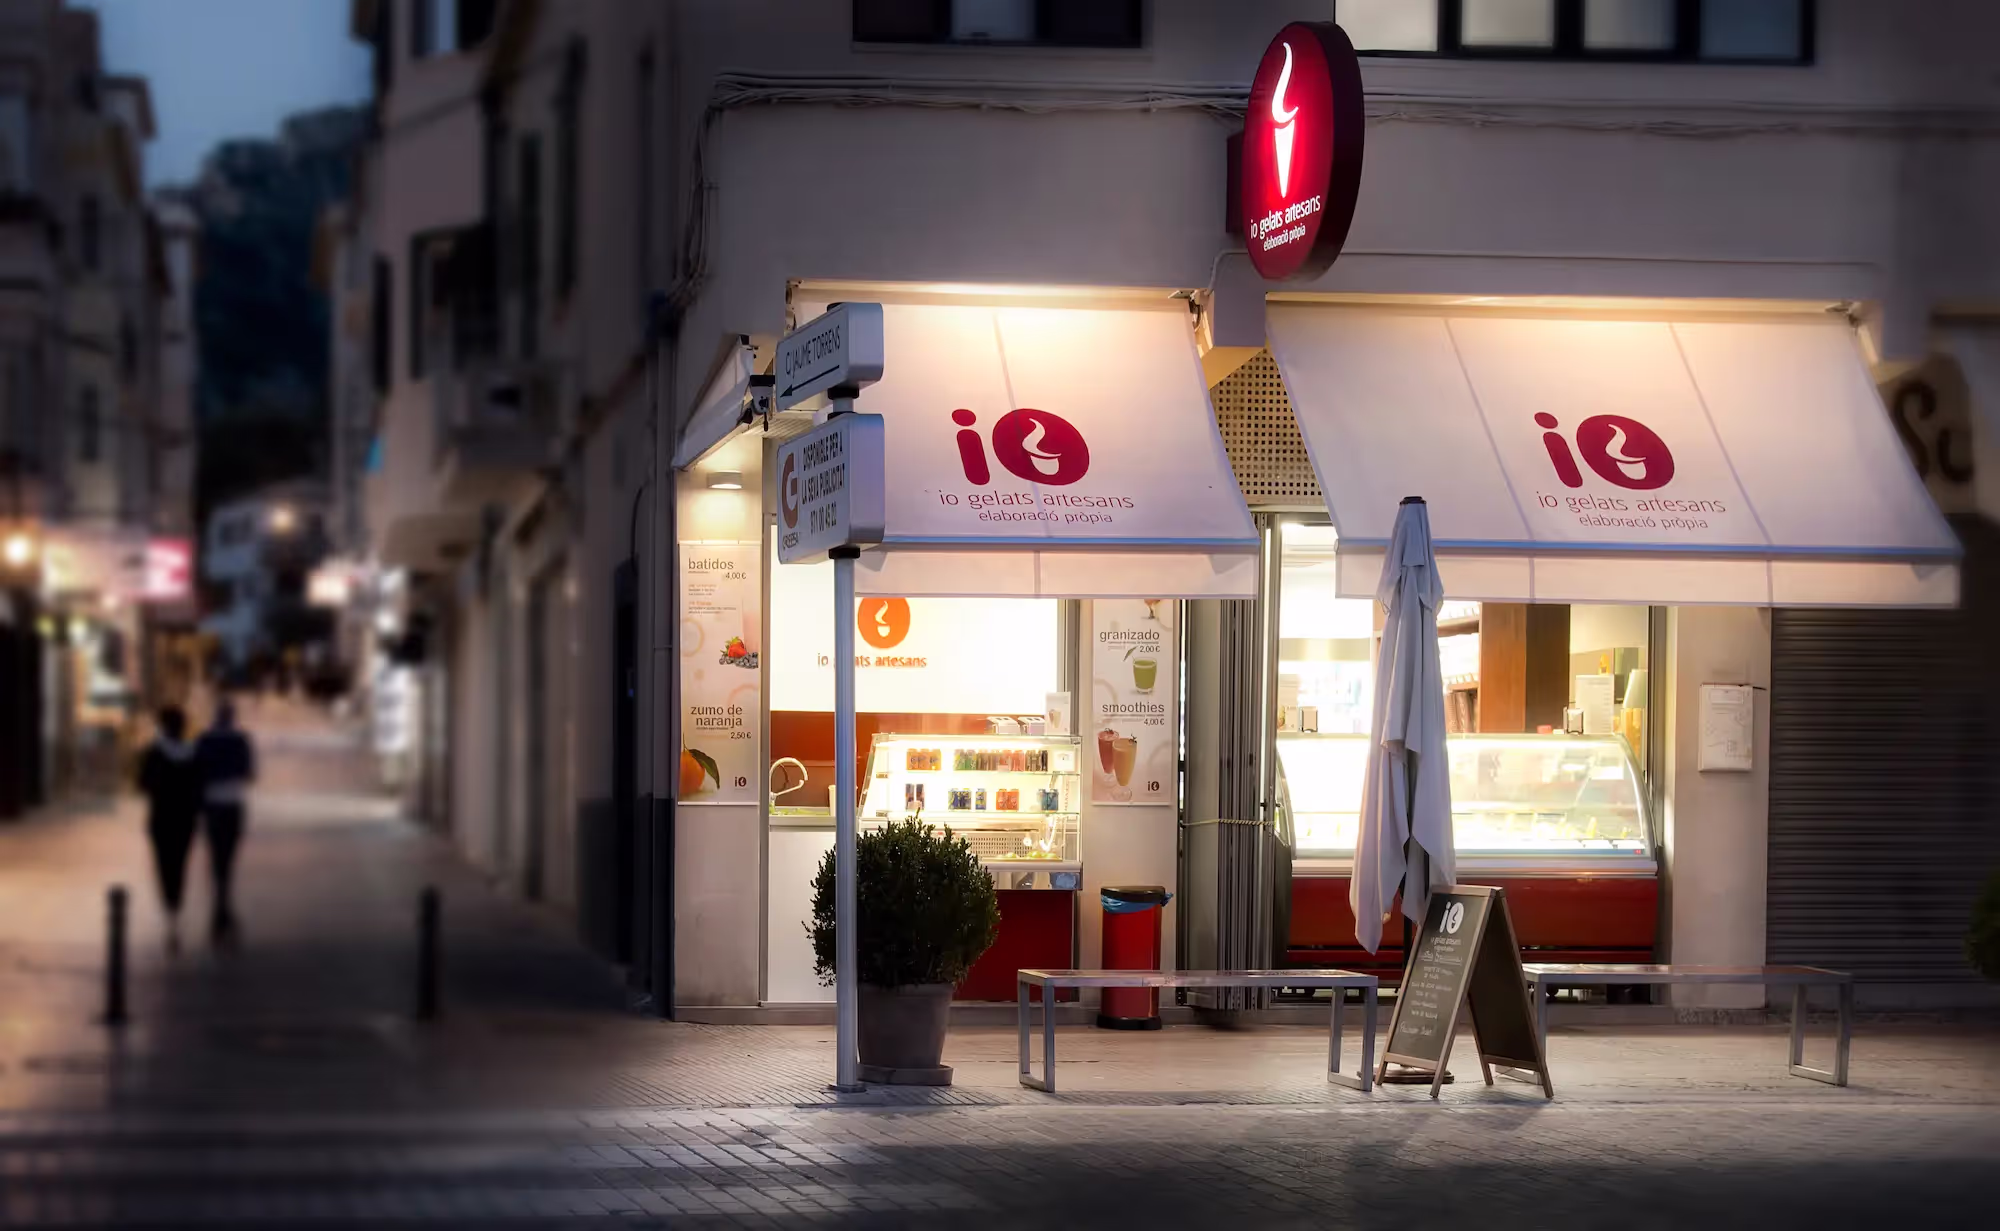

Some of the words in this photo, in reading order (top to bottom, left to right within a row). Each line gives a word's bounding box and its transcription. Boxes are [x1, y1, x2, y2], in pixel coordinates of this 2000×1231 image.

[1250, 218, 1258, 240] io
[1260, 209, 1283, 240] gelats
[1285, 195, 1320, 224] artesans
[812, 325, 840, 362] TORRENS
[829, 431, 838, 458] PER
[938, 489, 959, 506] io
[968, 490, 1034, 510] gelats
[1043, 492, 1135, 509] artesans
[1536, 490, 1558, 509] io
[1565, 493, 1628, 513] gelats
[1637, 495, 1727, 513] artesans
[978, 509, 1059, 522] elaboració
[1064, 511, 1113, 525] pròpia
[1578, 514, 1656, 528] elaboració
[1661, 516, 1709, 531] pròpia
[688, 557, 734, 570] batidos
[1100, 628, 1160, 642] granizado
[875, 655, 927, 668] artesans
[690, 705, 724, 715] zumo
[727, 704, 743, 715] de
[1102, 701, 1165, 713] smoothies
[695, 716, 742, 728] naranja
